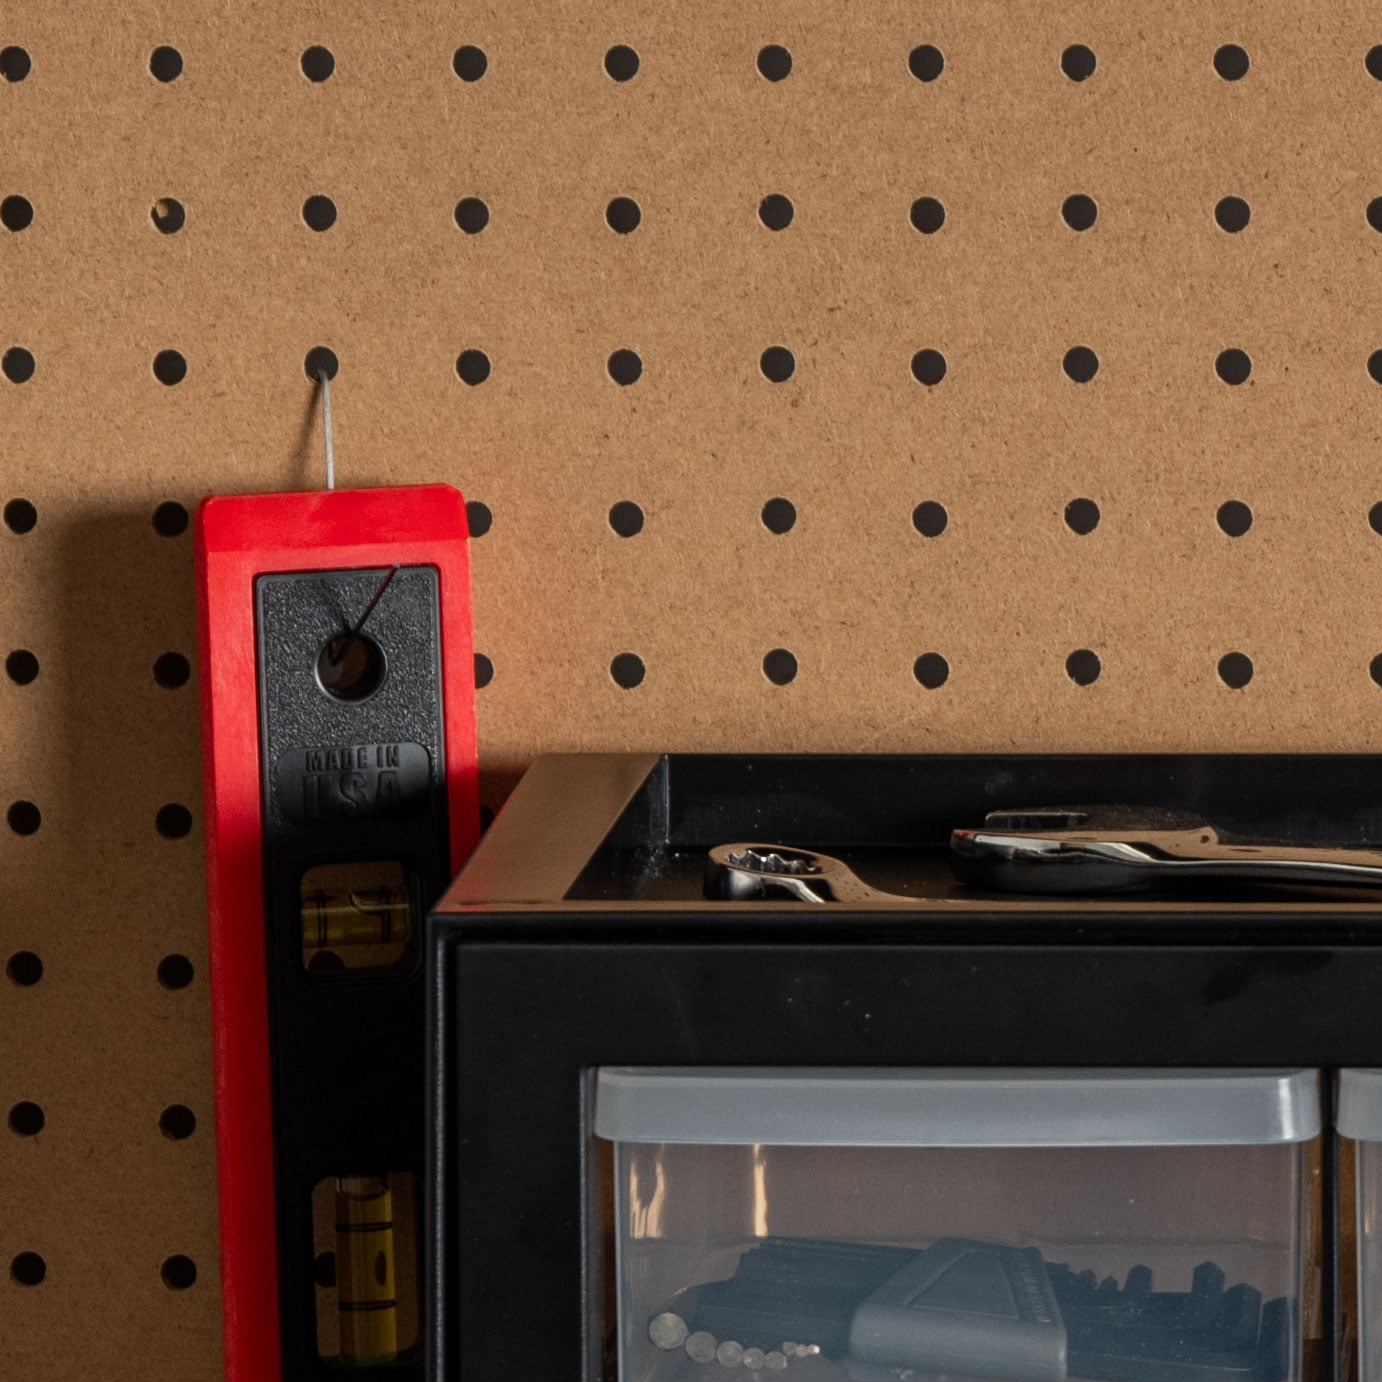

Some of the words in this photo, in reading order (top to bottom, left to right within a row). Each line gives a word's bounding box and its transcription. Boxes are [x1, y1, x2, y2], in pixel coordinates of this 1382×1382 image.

[305, 746, 369, 772] MADE
[376, 745, 400, 768] IN
[302, 770, 403, 821] USA
